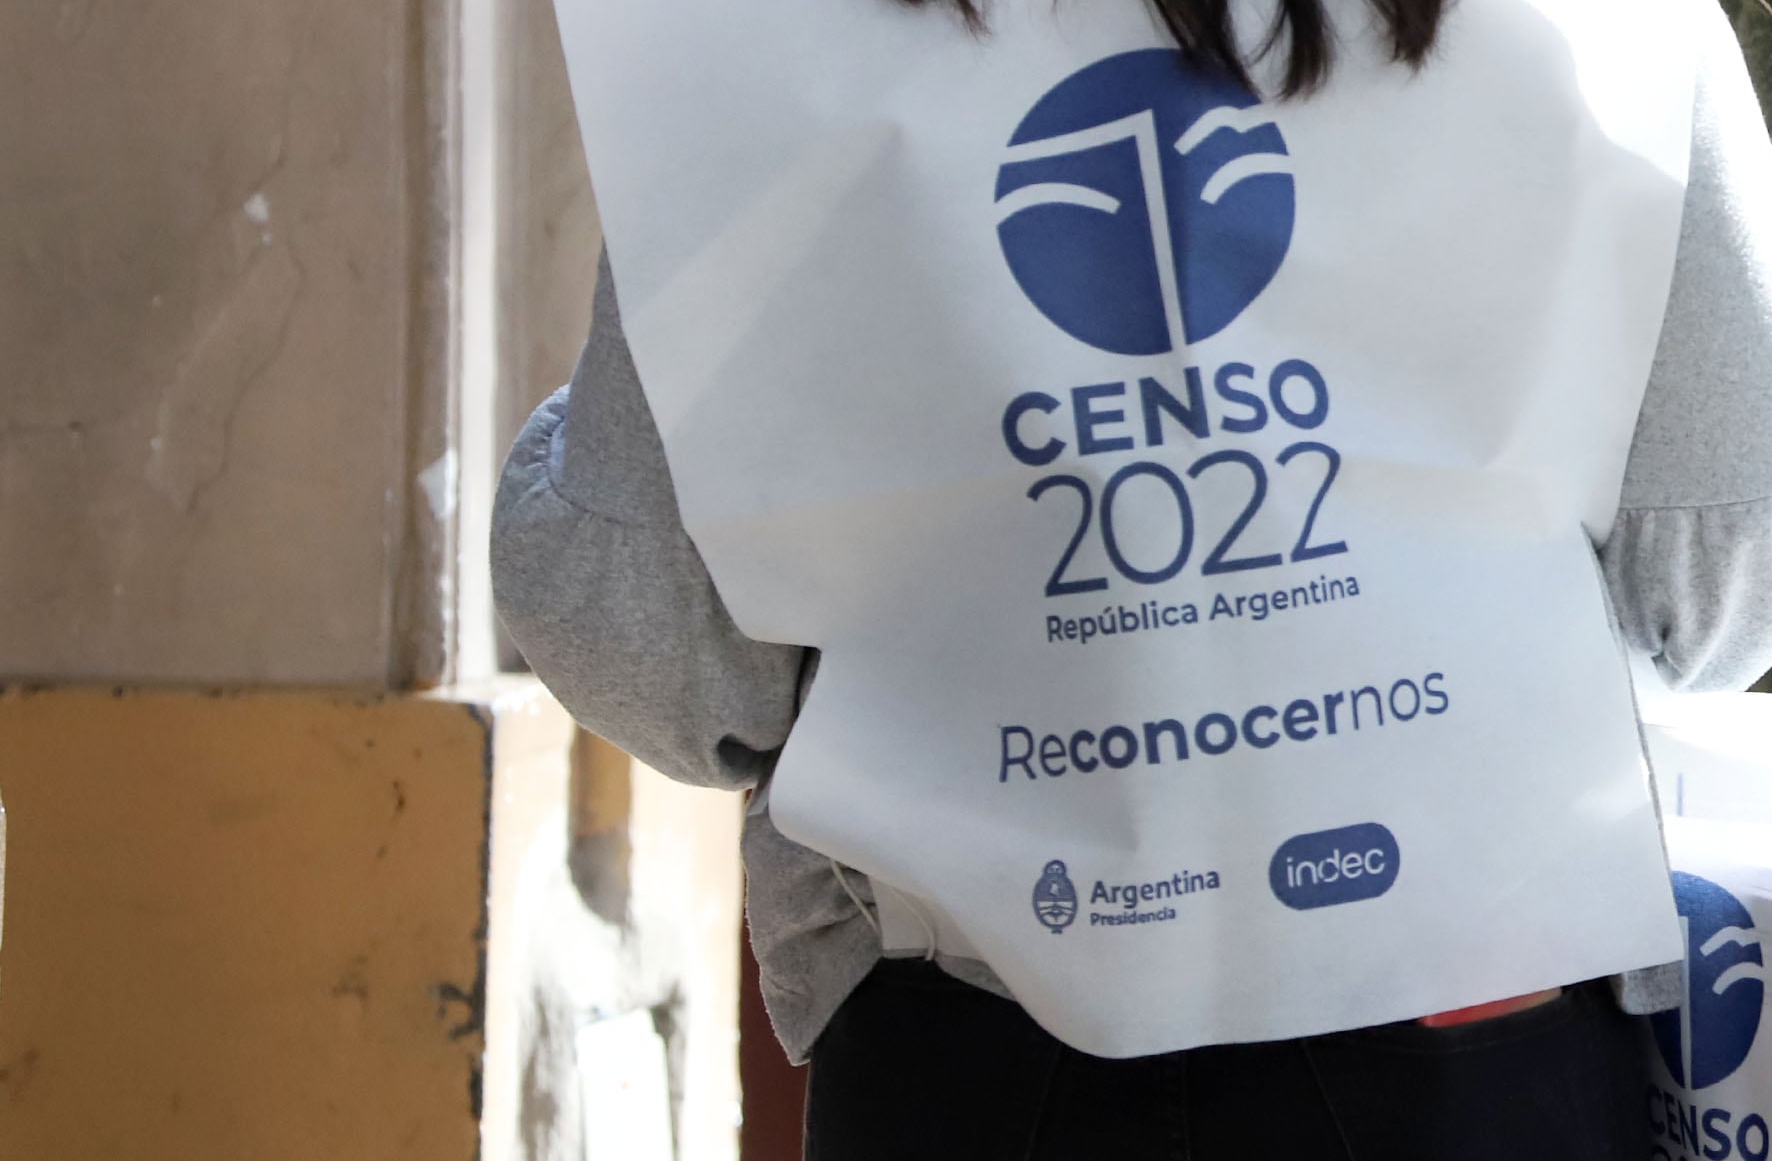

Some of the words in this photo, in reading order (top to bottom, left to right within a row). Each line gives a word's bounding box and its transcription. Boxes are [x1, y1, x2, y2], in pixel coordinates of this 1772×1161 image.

[1001, 358, 1330, 467] CENSO
[1026, 441, 1349, 598] 2022
[1046, 601, 1200, 645] República
[1208, 575, 1361, 622] Argentina
[999, 672, 1450, 783] Reconocernos
[1090, 870, 1221, 909] Argentina
[1286, 847, 1386, 889] indec
[1090, 905, 1177, 928] Presidencia
[1647, 1082, 1770, 1161] CENSO
